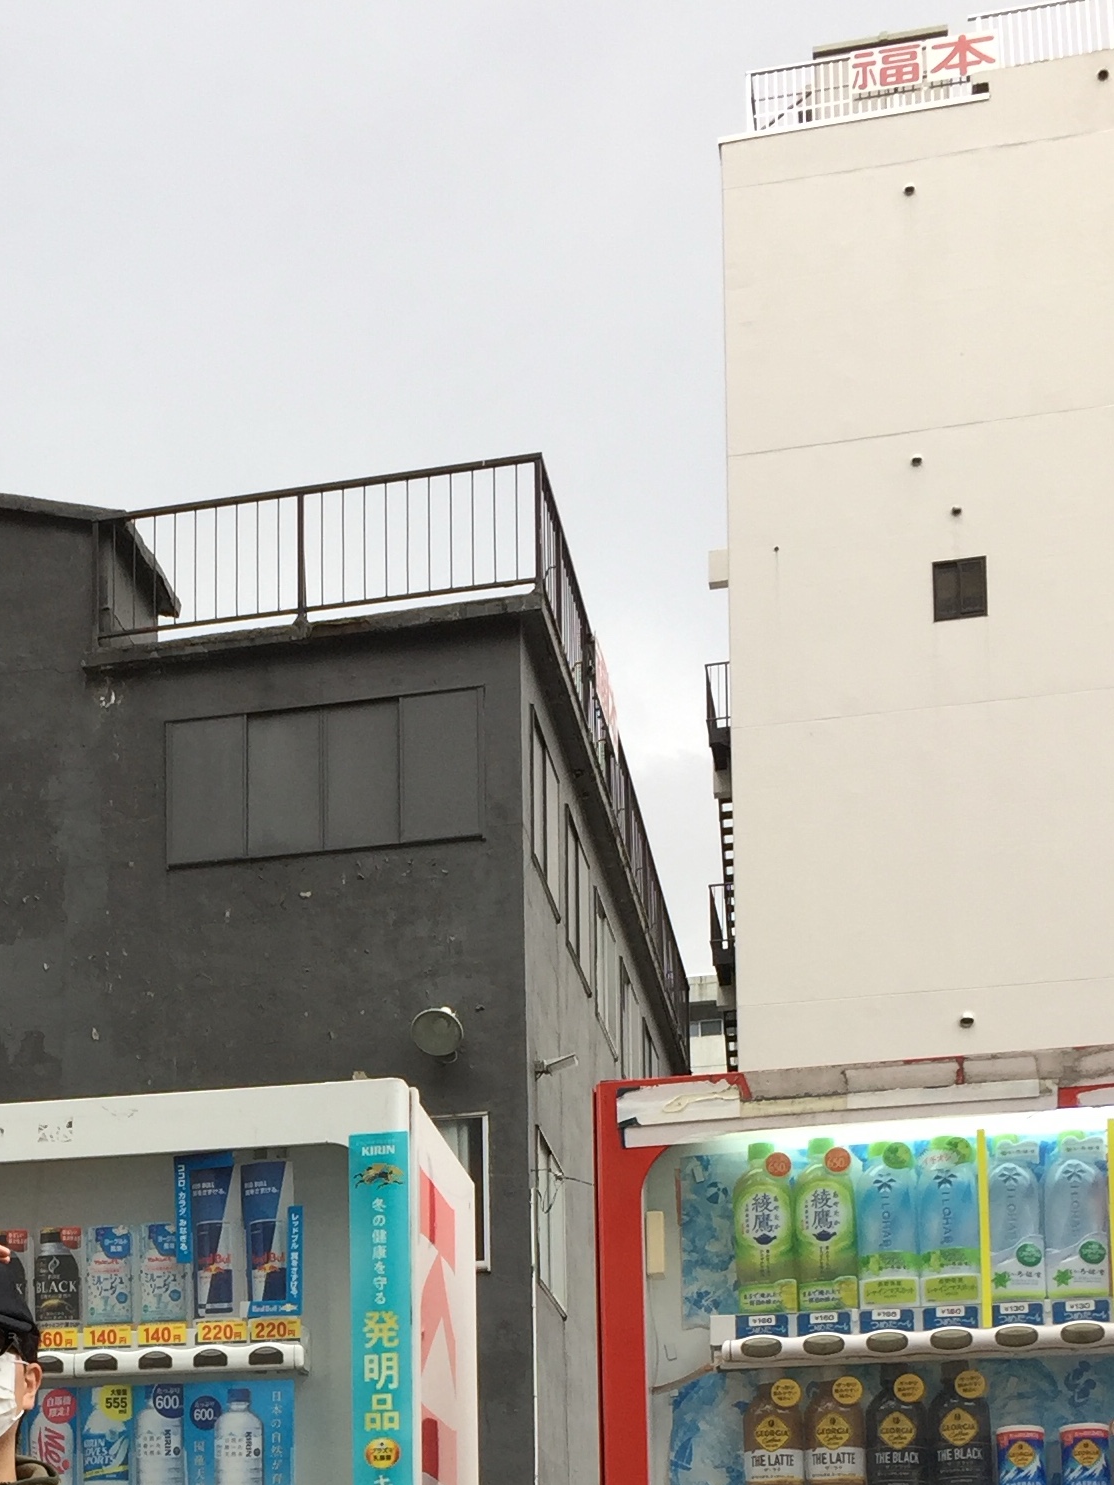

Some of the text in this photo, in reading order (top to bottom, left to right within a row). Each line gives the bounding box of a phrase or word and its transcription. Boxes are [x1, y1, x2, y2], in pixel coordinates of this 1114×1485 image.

[851, 34, 996, 91] 福本
[361, 1144, 396, 1156] KIRIN
[751, 1193, 775, 1233] 綾鷹
[811, 1189, 834, 1231] 綾鷹
[372, 1197, 388, 1305] 冬の健康を守る
[36, 1280, 78, 1294] BLACK
[89, 1328, 127, 1345] 140円
[143, 1326, 182, 1344] 140円
[201, 1323, 242, 1341] 220円
[254, 1321, 296, 1339] 220円
[40, 1331, 74, 1348] 60円
[363, 1311, 400, 1431] 発明品
[105, 1396, 128, 1410] 555
[155, 1394, 180, 1410] 600
[193, 1408, 215, 1421] 600
[751, 1454, 795, 1467] THE LATTE
[812, 1452, 856, 1465] THE LATTE
[875, 1452, 920, 1465] THE BLACK
[937, 1448, 984, 1462] THE BLACK
